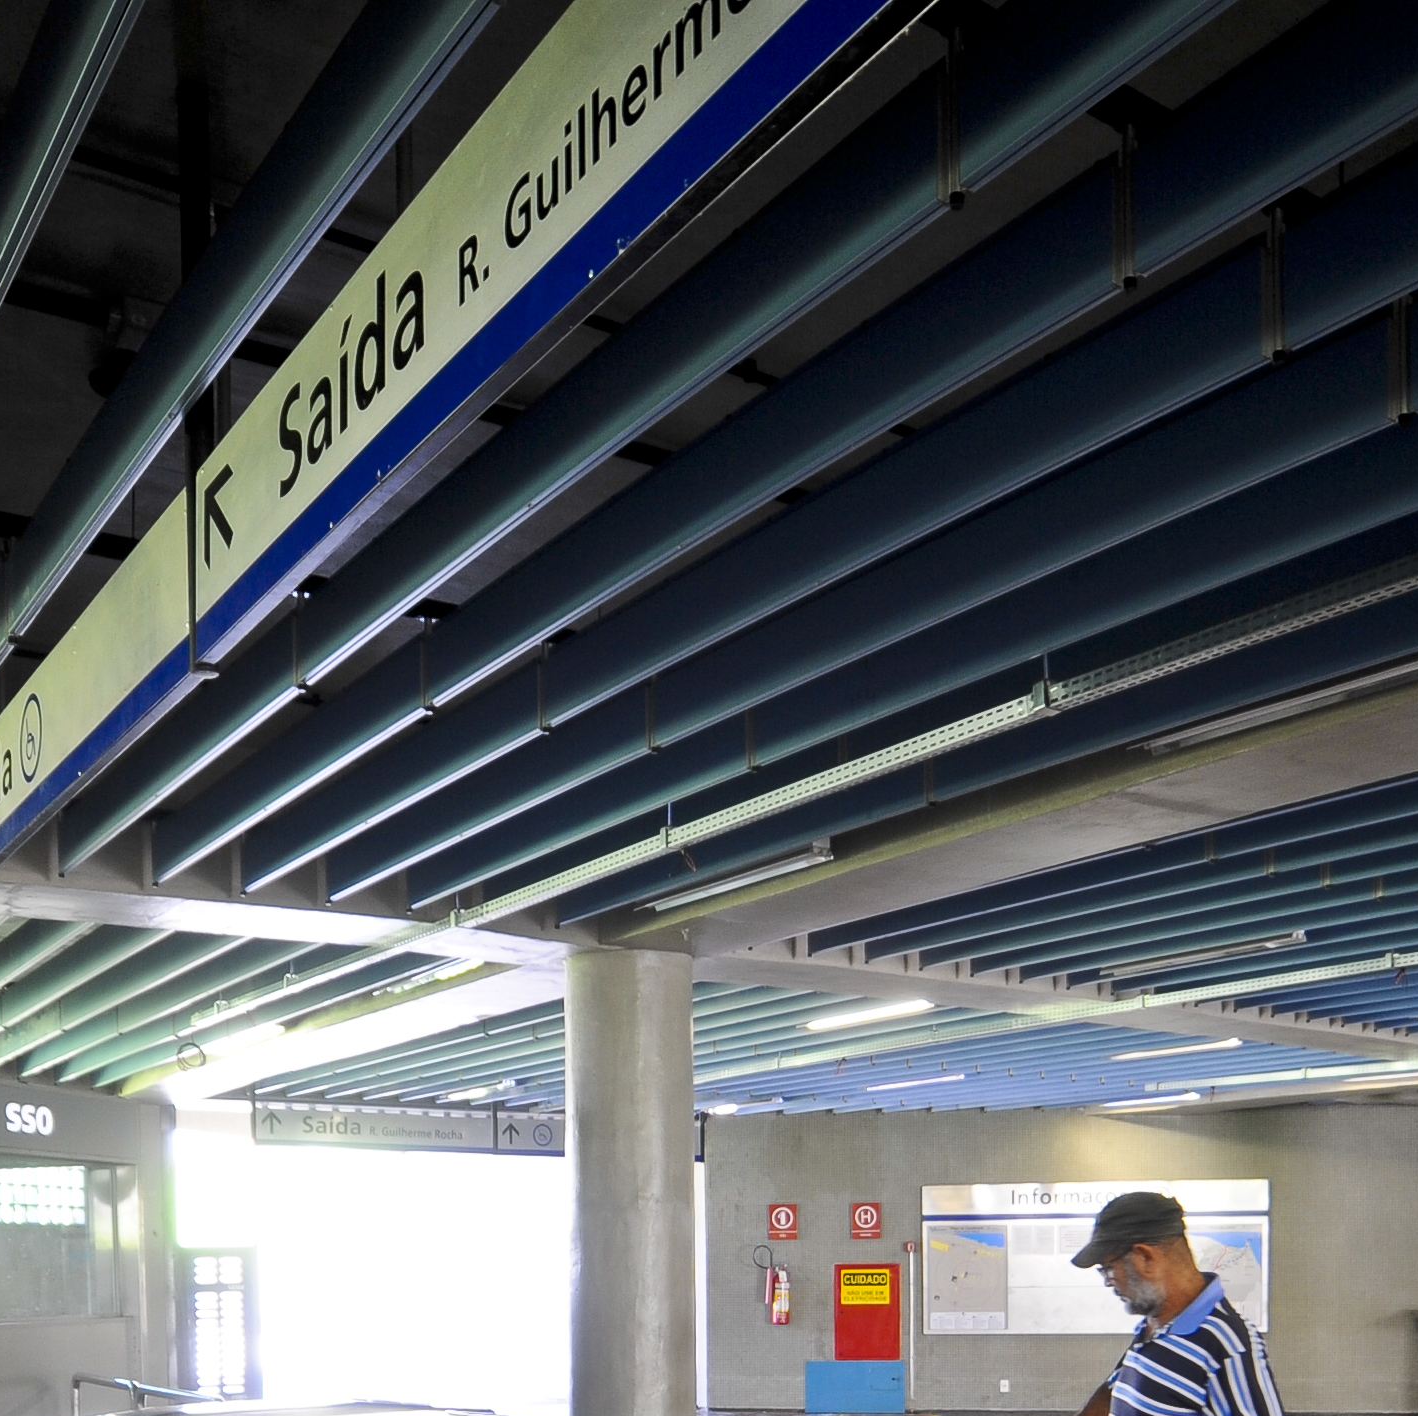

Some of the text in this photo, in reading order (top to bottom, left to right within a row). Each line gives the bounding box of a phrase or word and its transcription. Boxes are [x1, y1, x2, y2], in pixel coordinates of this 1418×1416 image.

[279, 0, 752, 498] Saída R. Guilherm
[5, 1102, 54, 1136] SSO
[302, 1114, 464, 1141] Saída R. Guilherme Rocha
[1011, 1187, 1125, 1209] Informaçõ
[844, 1274, 887, 1285] CUIDADO
